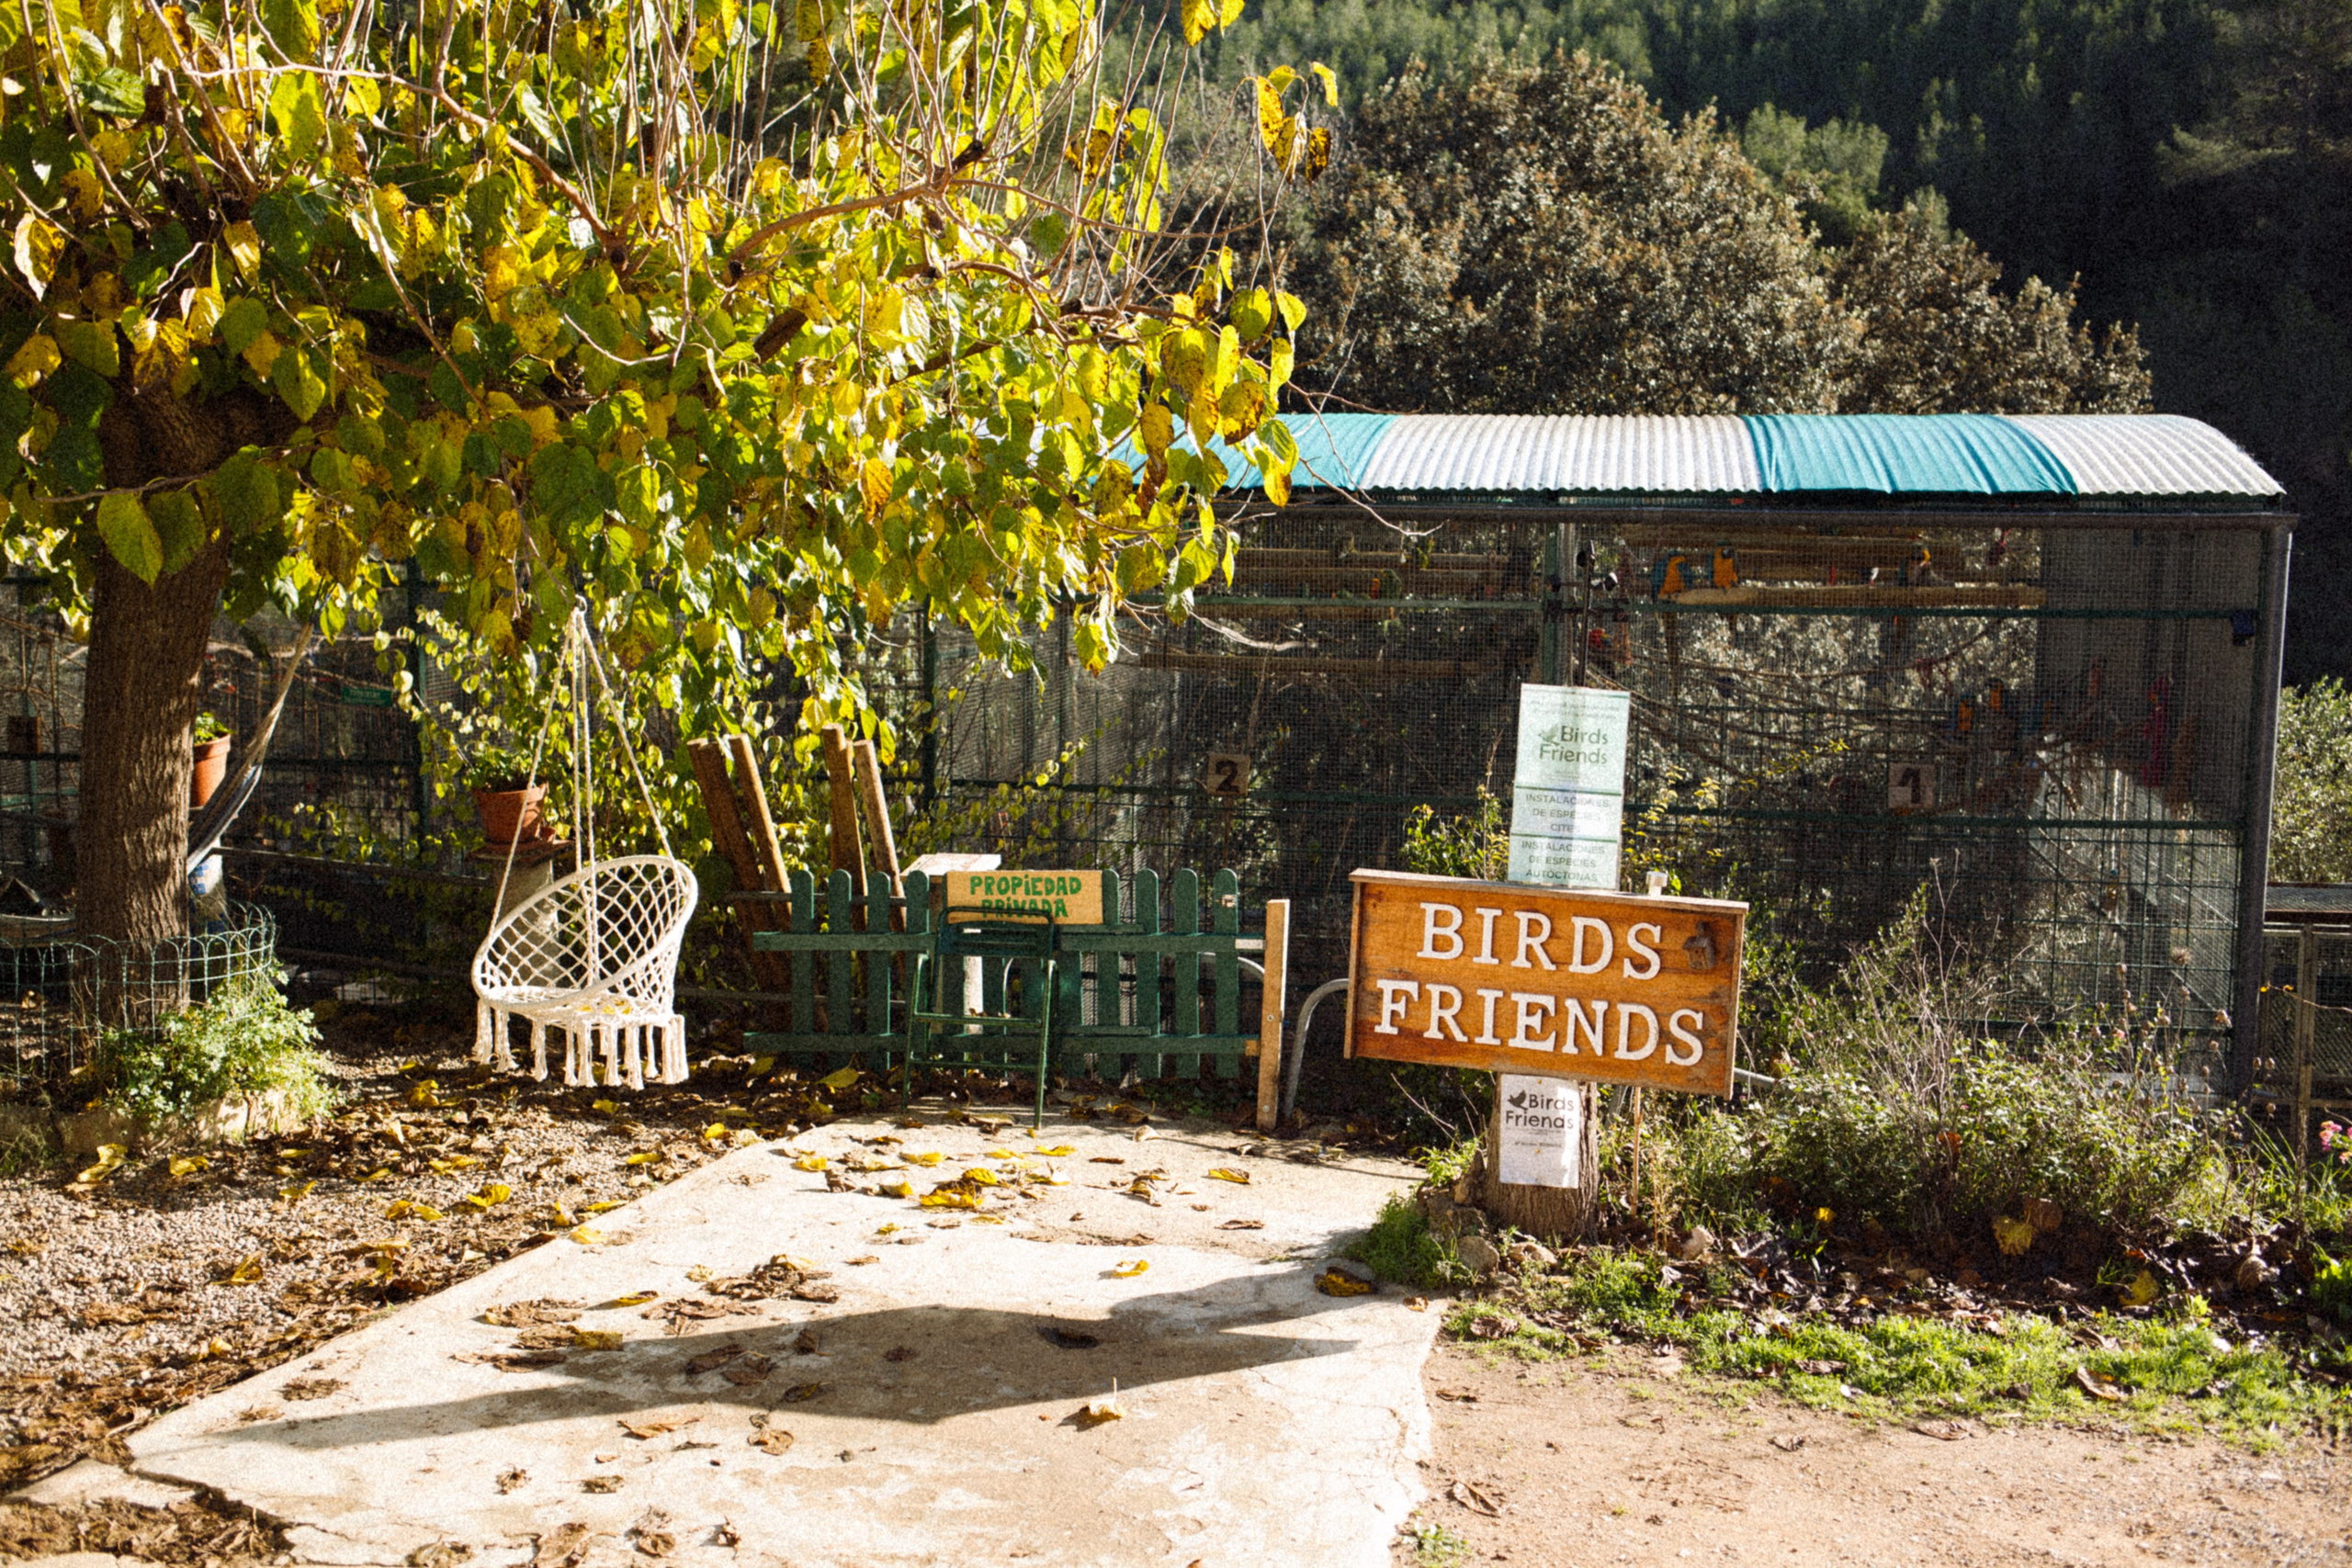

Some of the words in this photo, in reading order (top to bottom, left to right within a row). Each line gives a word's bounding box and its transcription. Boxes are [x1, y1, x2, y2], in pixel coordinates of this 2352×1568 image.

[1560, 726, 1609, 745] Birds
[1539, 743, 1608, 764] Friends
[1215, 760, 1240, 794] 2
[1898, 767, 1921, 805] 1
[1525, 794, 1610, 808] INSTALACIONES
[1532, 807, 1546, 818] DE
[1549, 808, 1601, 822] ESPECIES
[1521, 840, 1606, 855] INSTALACIONES
[1528, 854, 1543, 864] DE
[1544, 856, 1597, 869] ESPECIES
[1416, 901, 1662, 981] BIRDS
[1374, 978, 1704, 1067] FRIENDS
[1528, 1093, 1575, 1111] Birds
[1505, 1110, 1575, 1130] Friends
